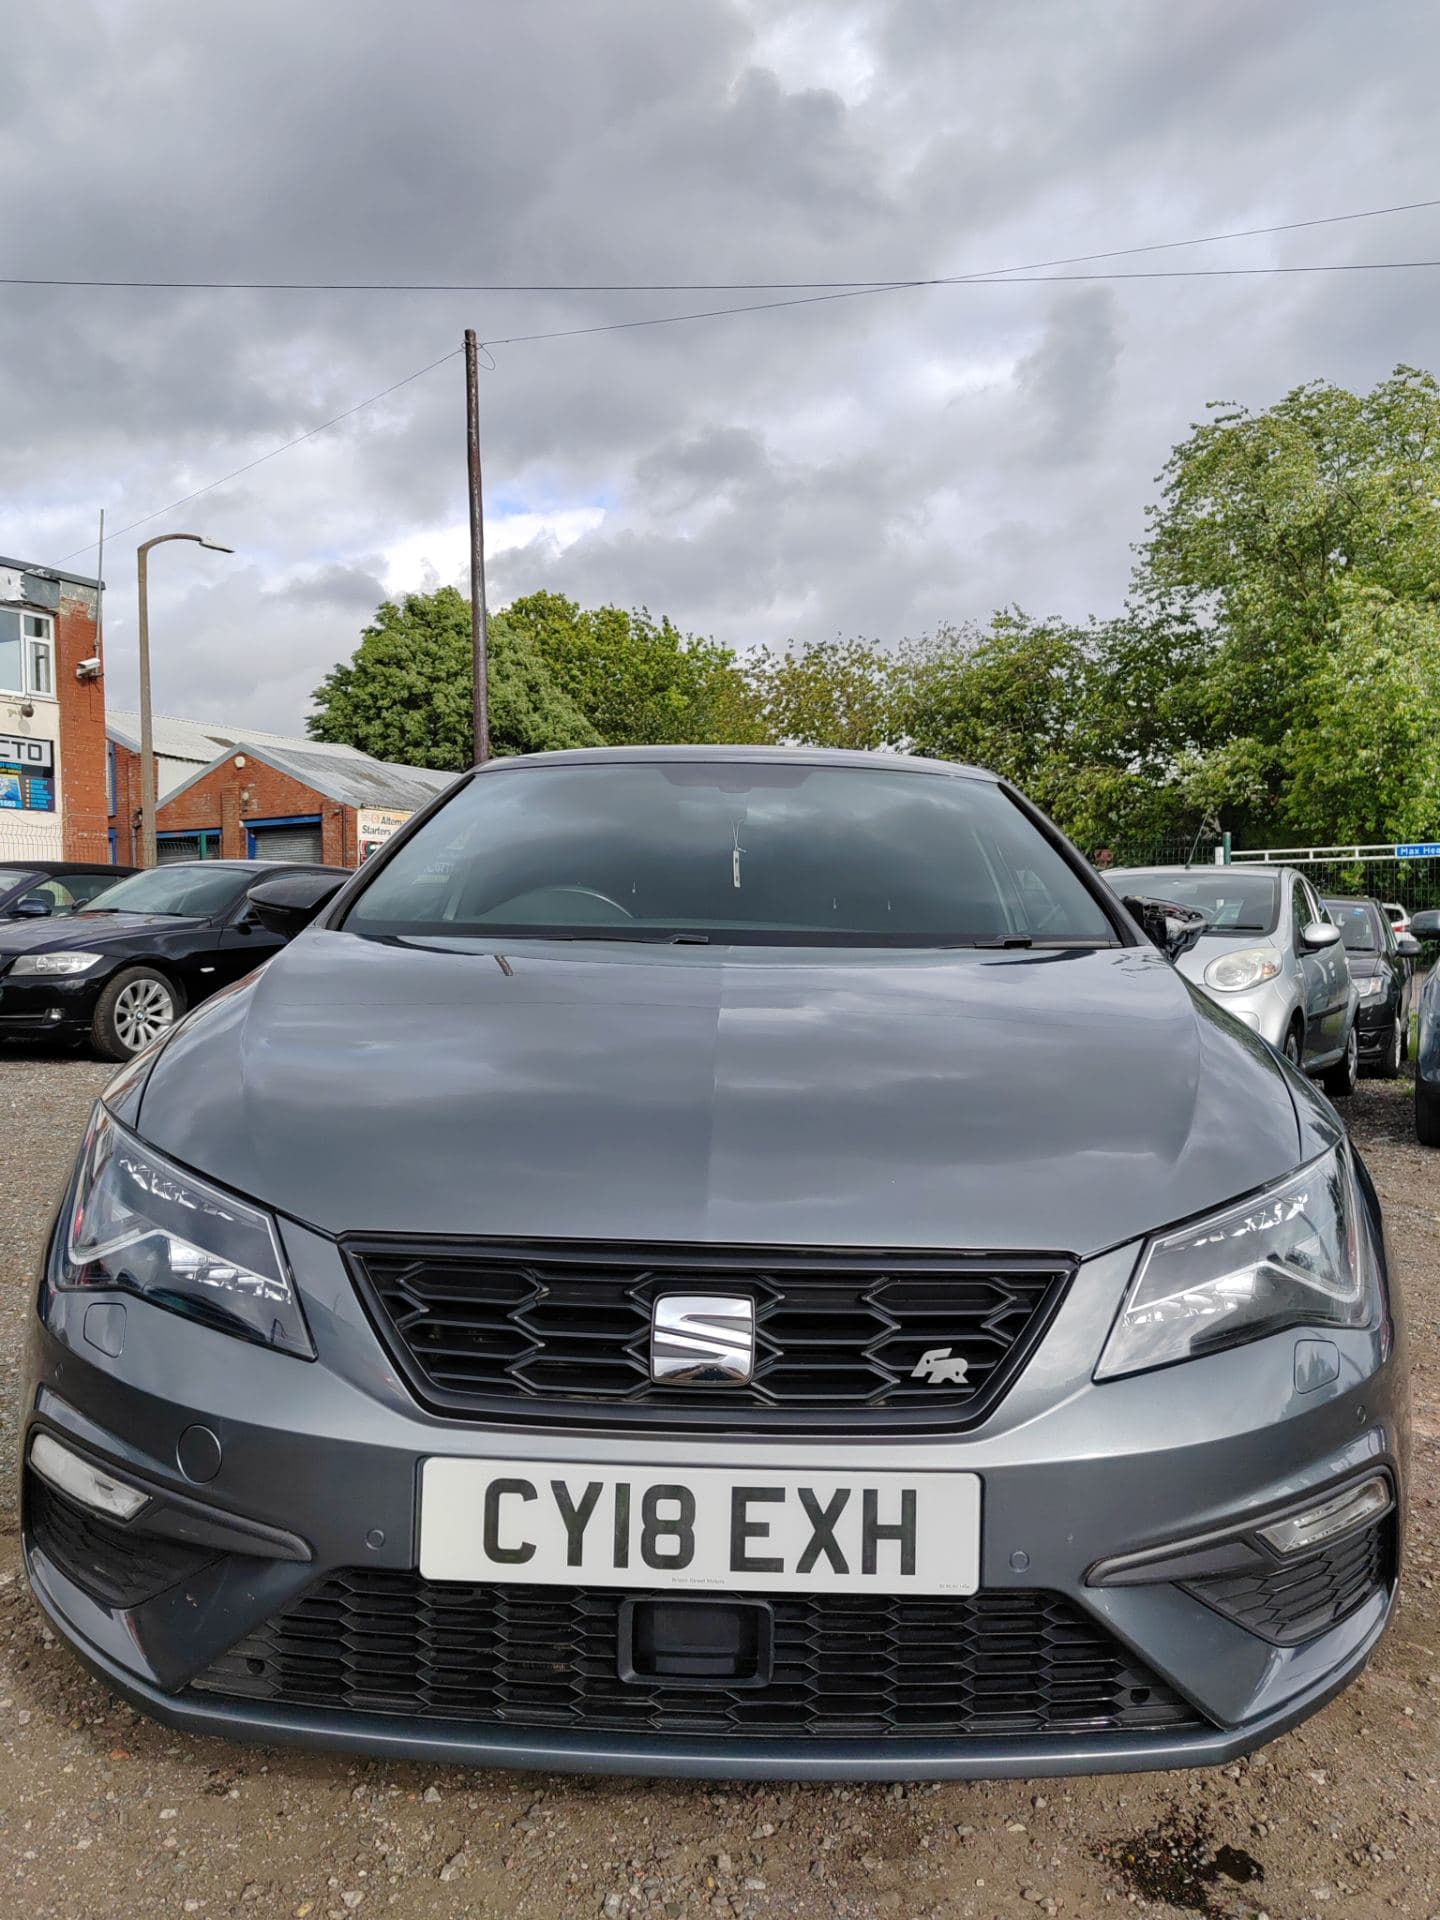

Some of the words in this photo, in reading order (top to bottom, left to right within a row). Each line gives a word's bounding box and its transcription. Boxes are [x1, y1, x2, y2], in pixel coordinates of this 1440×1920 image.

[381, 815, 404, 825] Altern
[362, 824, 391, 836] Starters
[1400, 847, 1420, 856] Max
[483, 1478, 697, 1570] CY18
[729, 1486, 918, 1576] EXH
